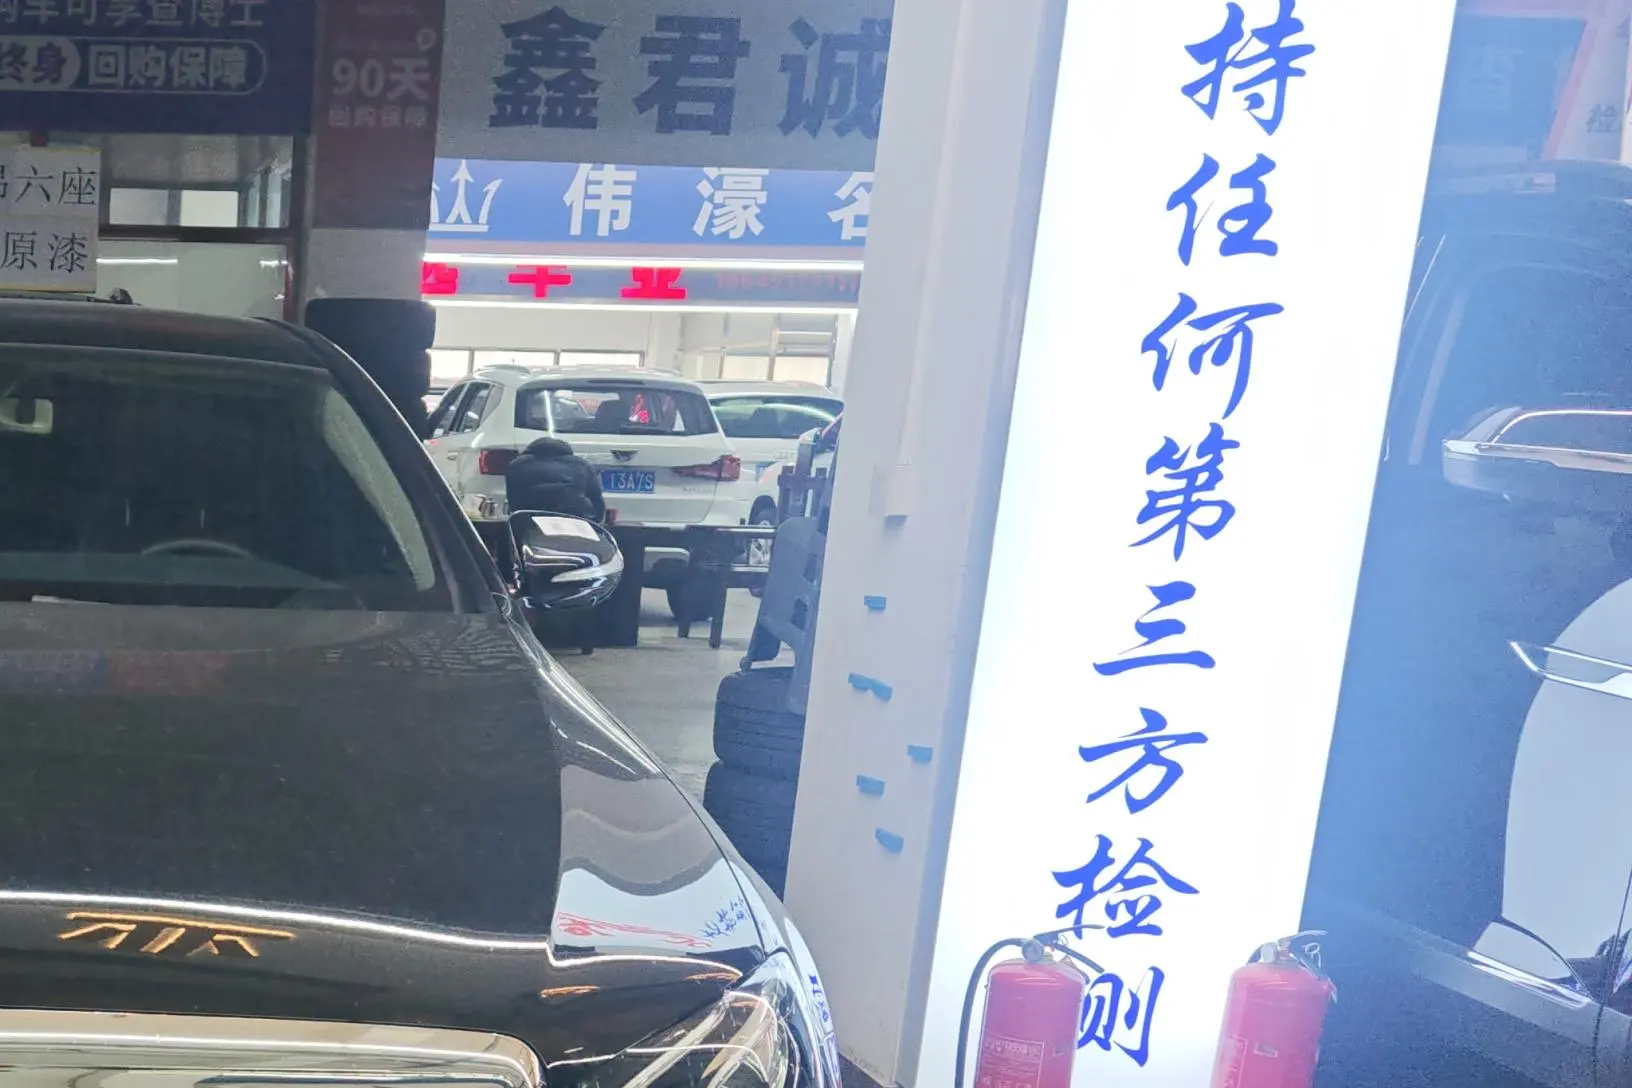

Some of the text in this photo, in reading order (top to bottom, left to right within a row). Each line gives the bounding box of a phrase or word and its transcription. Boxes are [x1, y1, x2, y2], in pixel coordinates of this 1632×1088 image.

[88, 44, 247, 88] 回购保障
[331, 57, 431, 100] 90天
